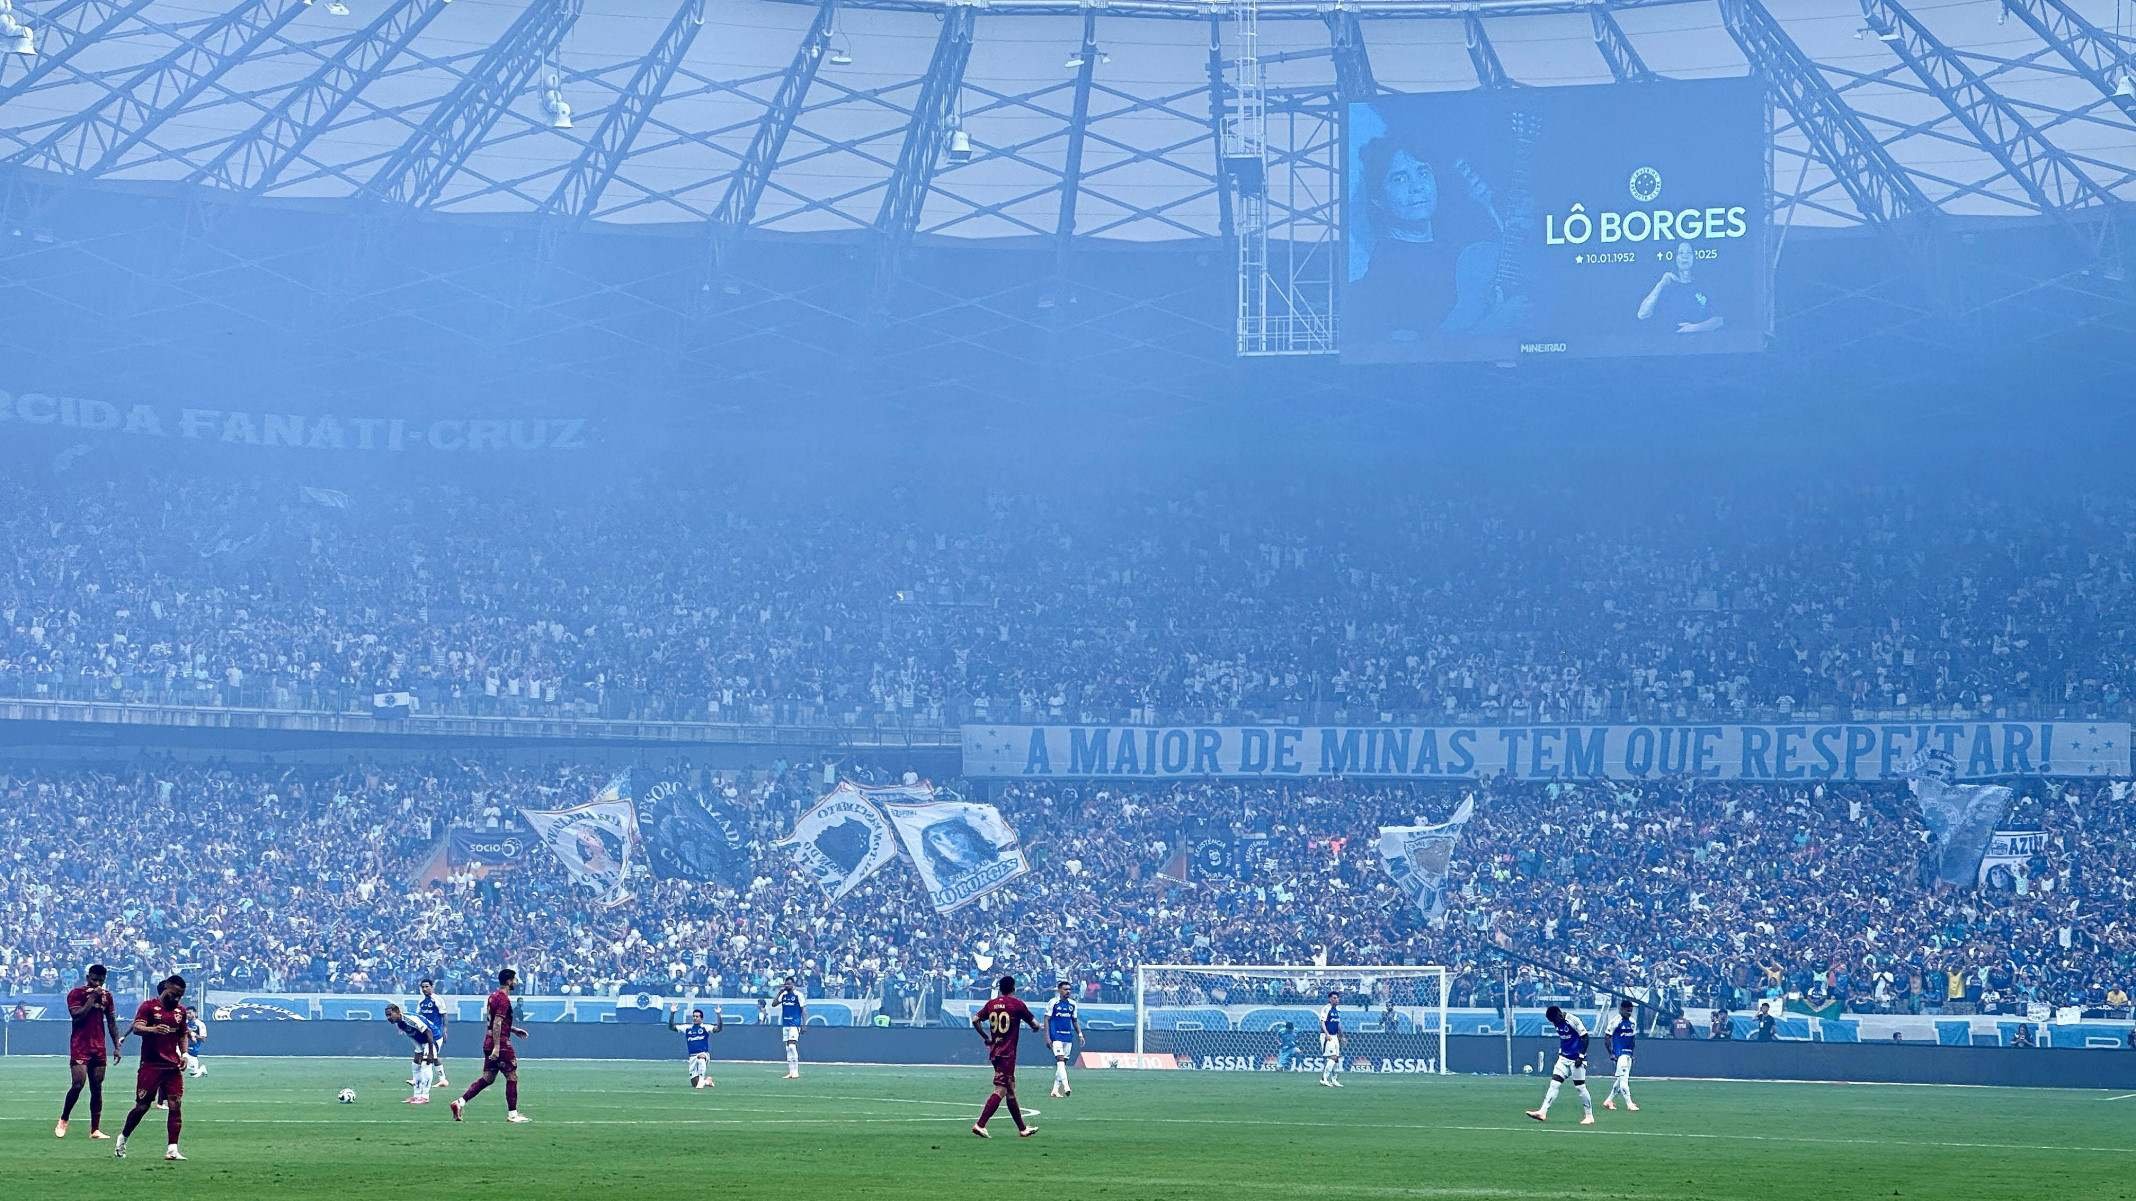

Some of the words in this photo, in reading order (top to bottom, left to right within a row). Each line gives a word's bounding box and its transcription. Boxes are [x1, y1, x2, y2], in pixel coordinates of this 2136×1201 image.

[1546, 203, 1592, 245] LÔ
[1600, 206, 1748, 242] BORGES
[1586, 252, 1635, 264] 10.01.1952
[1023, 727, 1052, 775] A
[1067, 727, 1222, 774] MAIOR
[1238, 728, 1303, 773] DE
[1500, 728, 1609, 777] TEM
[1624, 726, 1722, 778] QUE
[1740, 724, 2056, 778] RESPEITAR!
[956, 857, 1018, 899] BORGES
[989, 1011, 1010, 1034] 90
